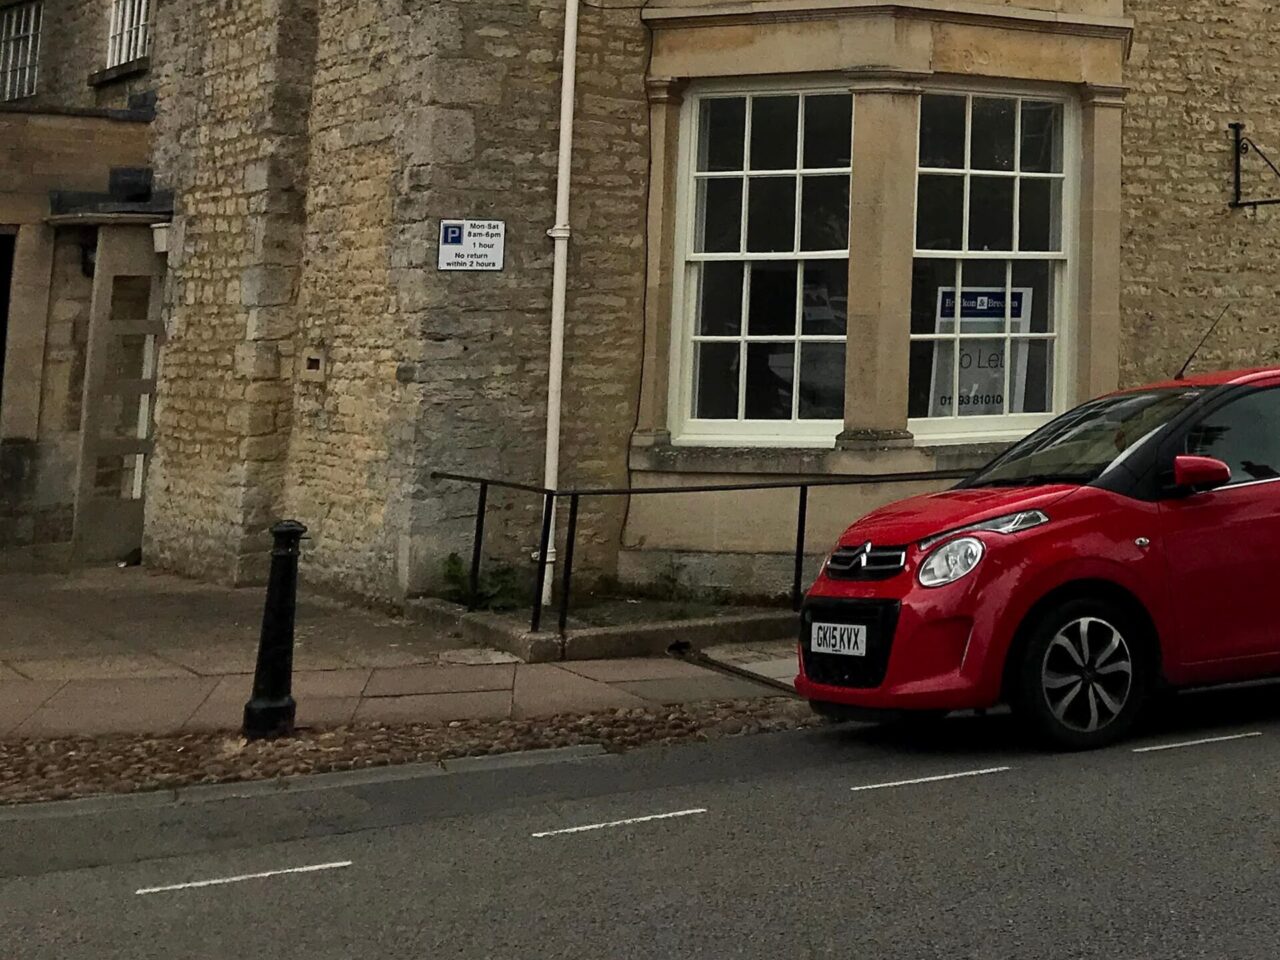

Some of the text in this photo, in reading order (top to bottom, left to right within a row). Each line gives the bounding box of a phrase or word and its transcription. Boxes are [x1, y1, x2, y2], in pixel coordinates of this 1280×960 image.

[940, 394, 1004, 406] 0193 81010
[817, 625, 860, 651] GK15 KVX
